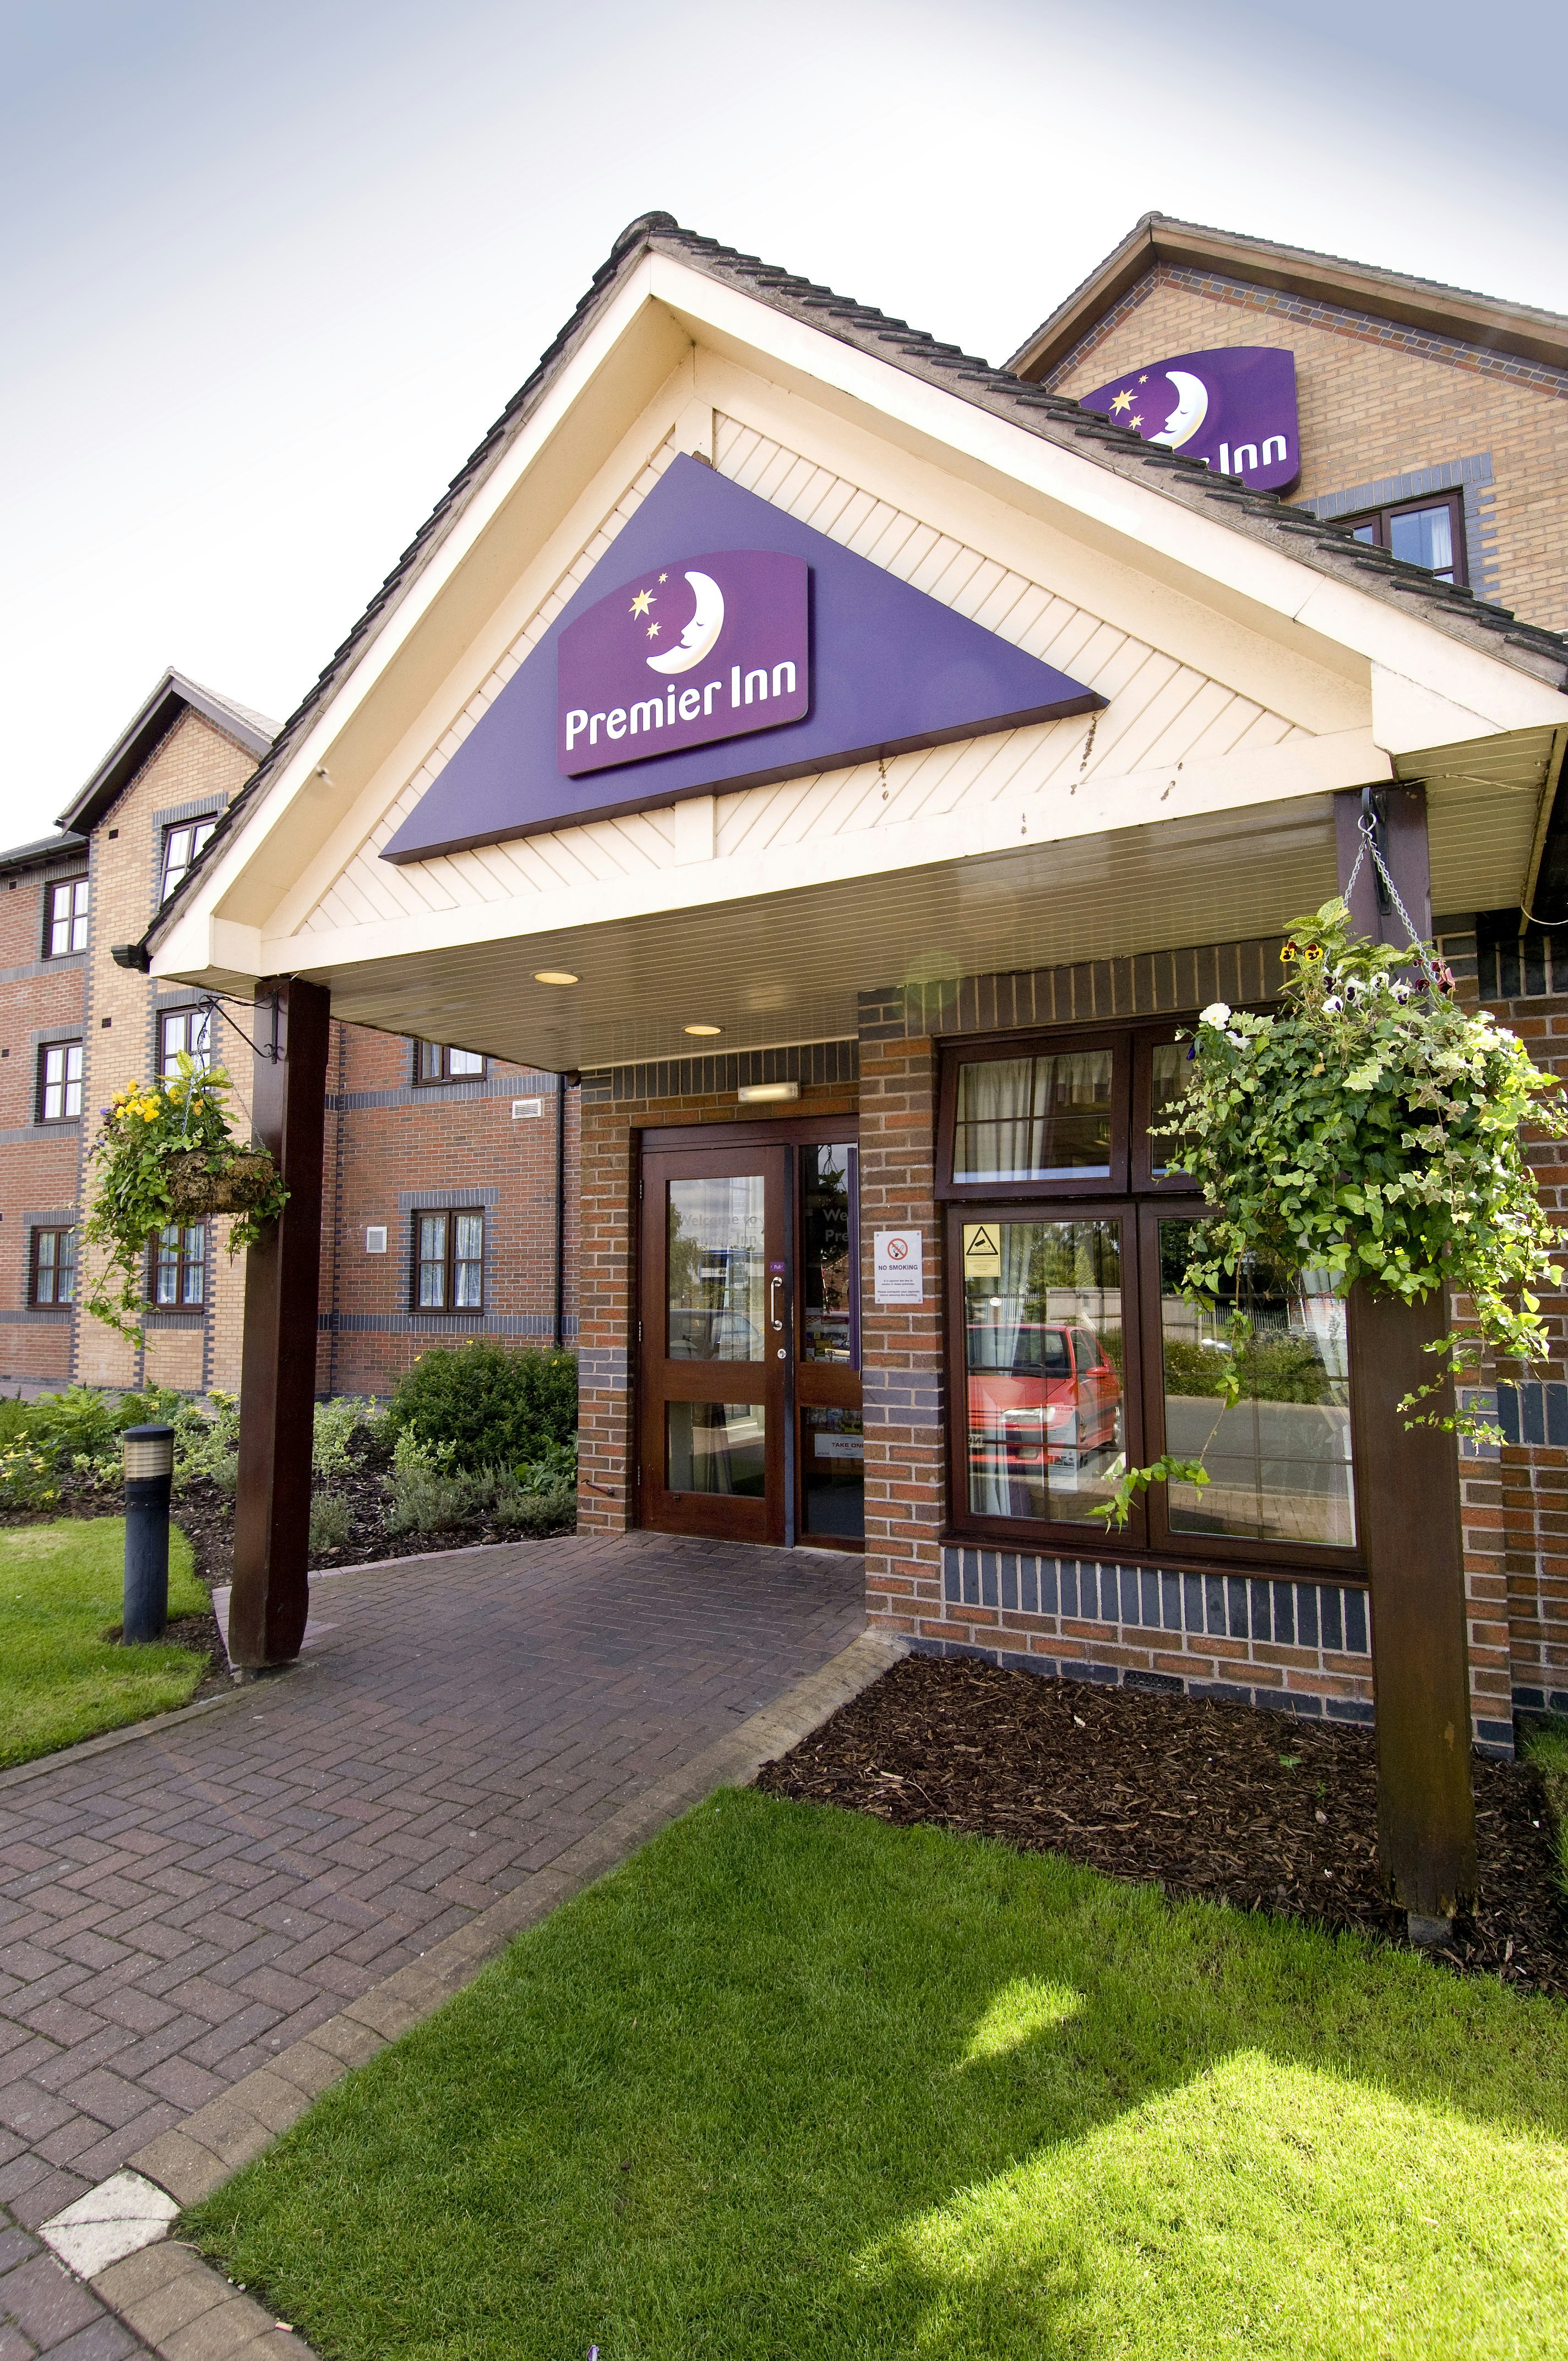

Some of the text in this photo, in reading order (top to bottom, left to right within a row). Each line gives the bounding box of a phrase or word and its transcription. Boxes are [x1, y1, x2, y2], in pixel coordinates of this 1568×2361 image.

[1219, 434, 1287, 475] Inn
[565, 661, 796, 751] Premier Inn
[679, 1215, 739, 1226] Welcome
[679, 1232, 757, 1245] Pmier Inn
